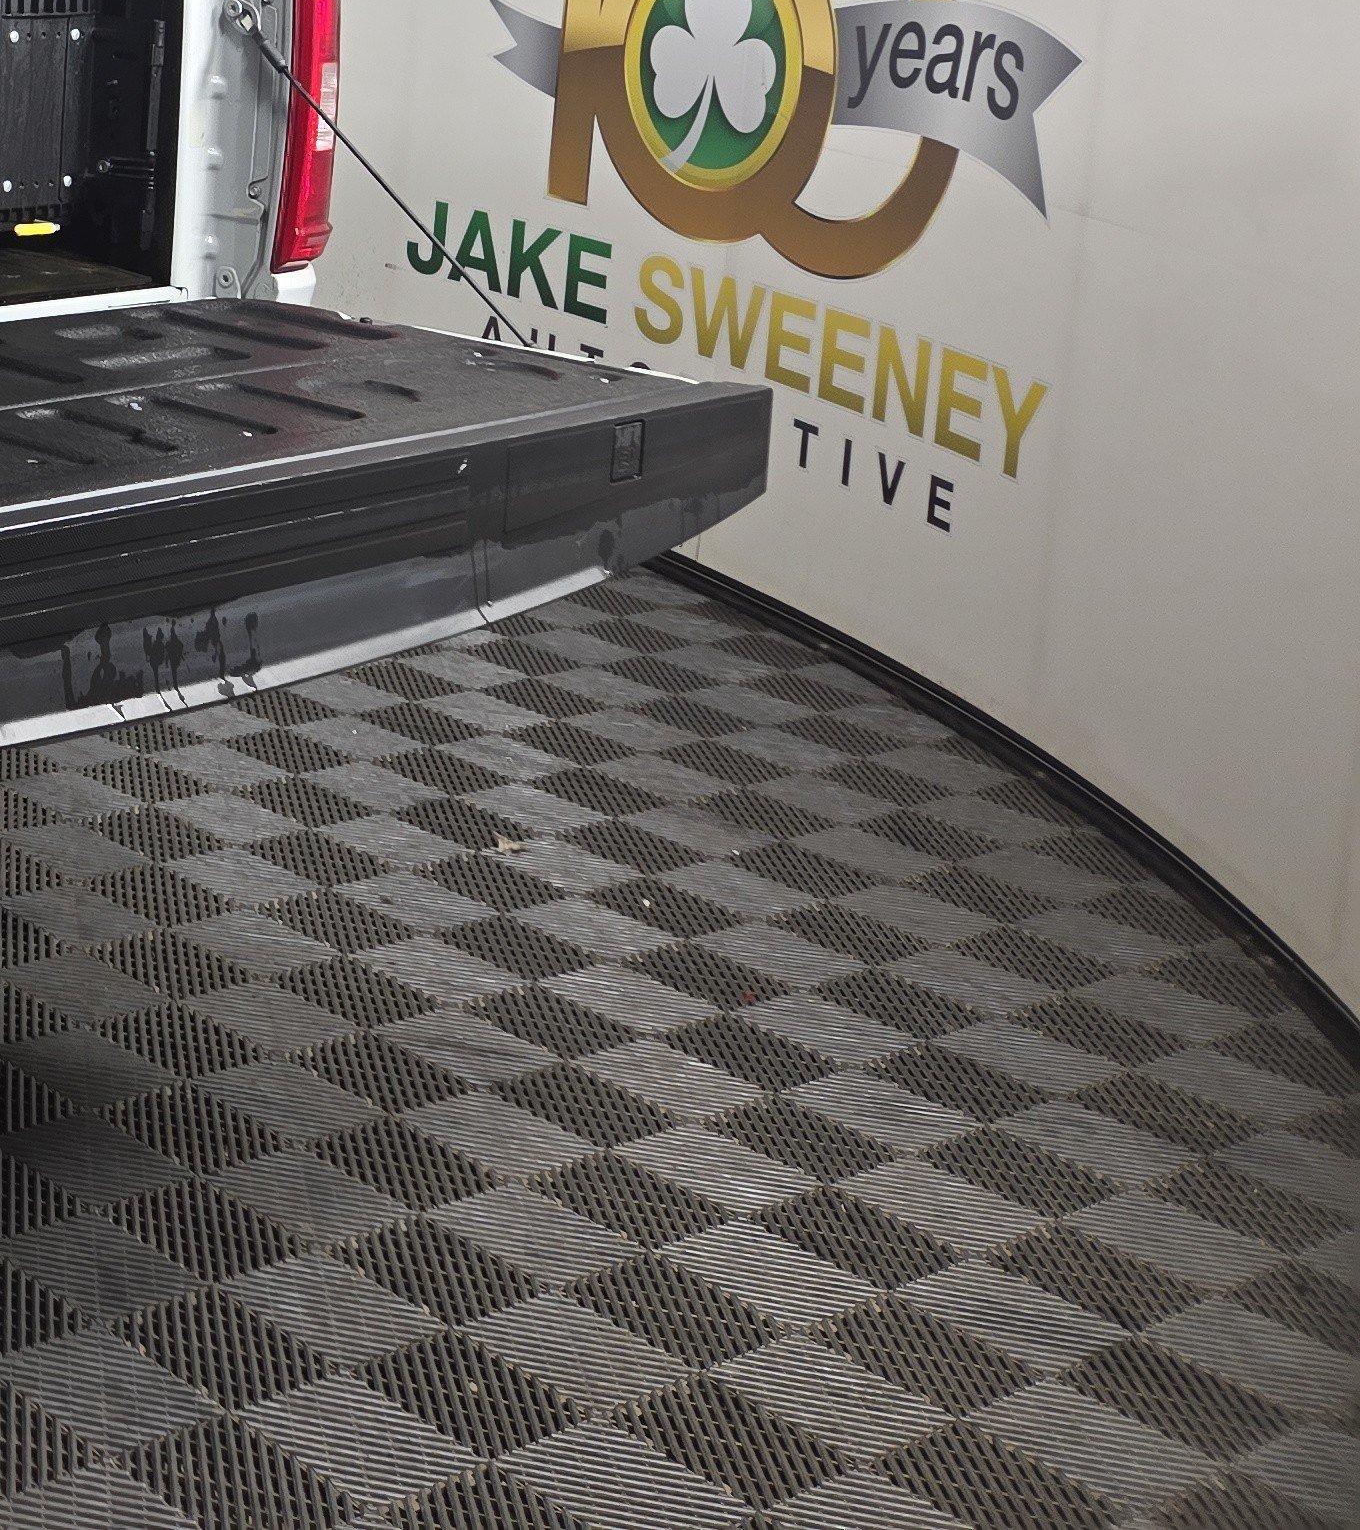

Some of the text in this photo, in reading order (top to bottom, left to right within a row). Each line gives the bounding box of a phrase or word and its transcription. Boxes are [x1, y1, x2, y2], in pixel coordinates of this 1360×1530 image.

[847, 20, 1025, 121] years
[407, 200, 1049, 480] JAKE SWEENEY
